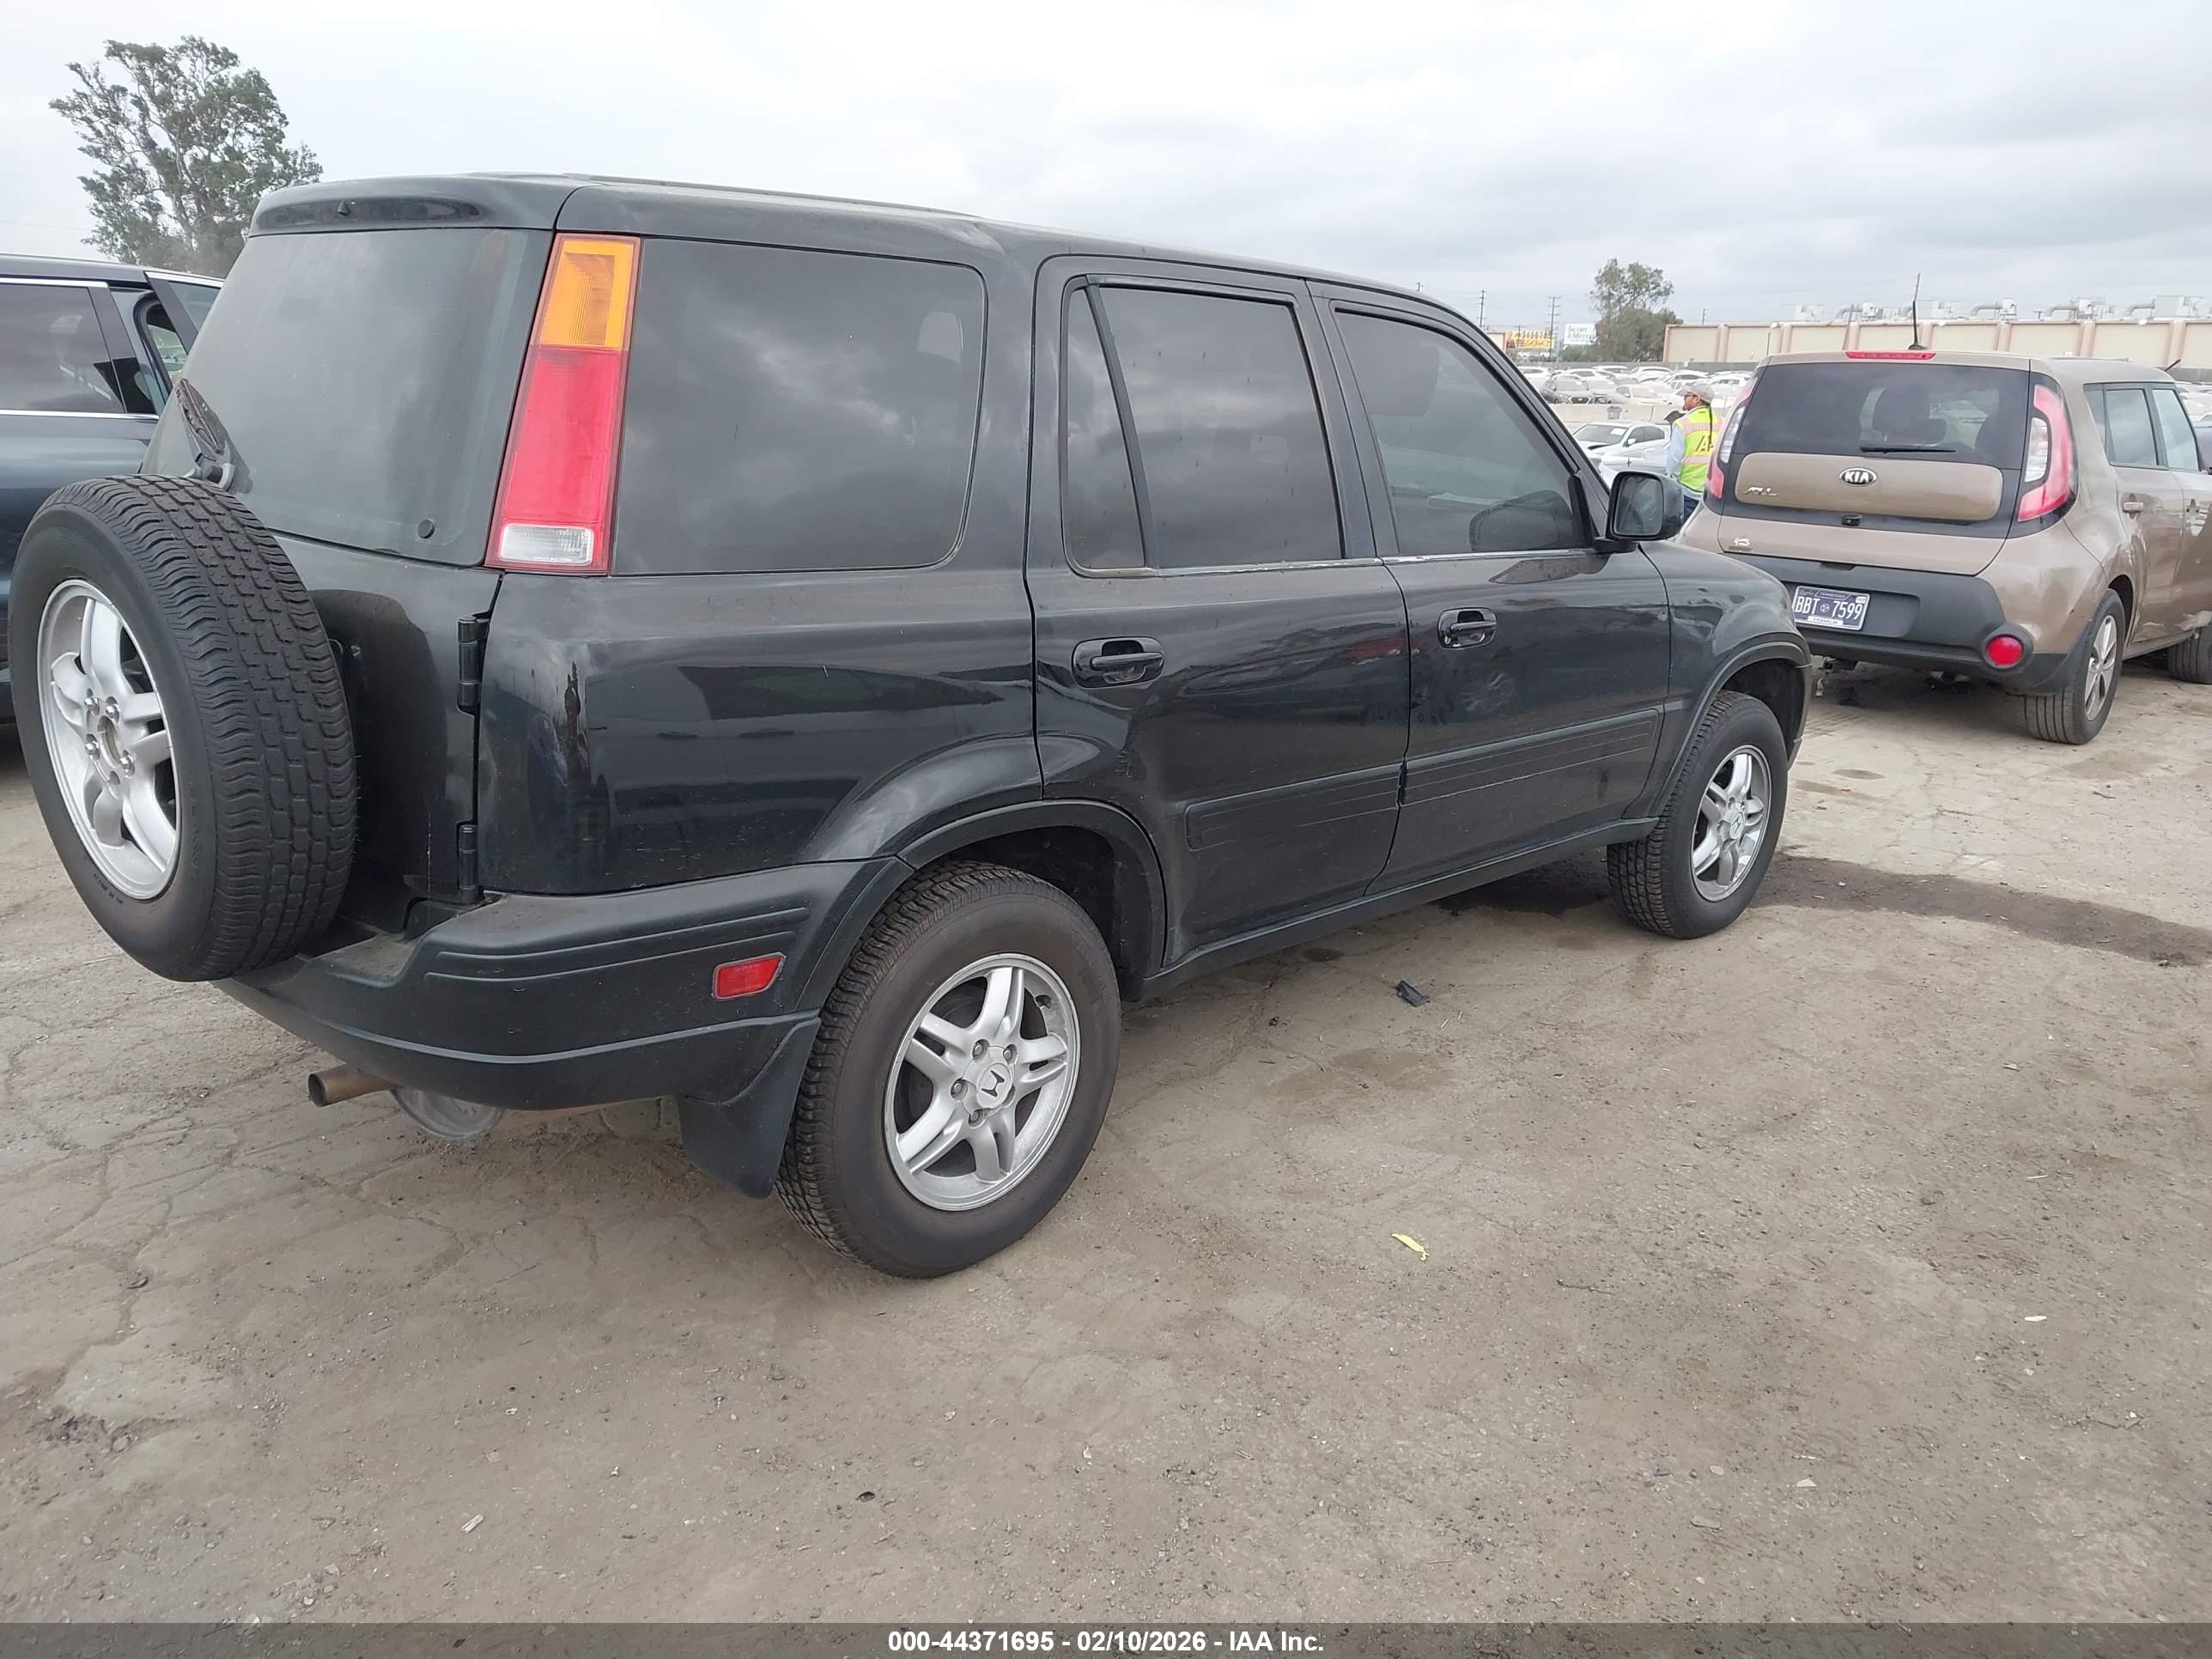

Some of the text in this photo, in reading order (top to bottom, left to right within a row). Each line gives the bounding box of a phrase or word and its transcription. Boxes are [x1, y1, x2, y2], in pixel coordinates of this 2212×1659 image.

[1845, 471, 1869, 483] KIA
[1795, 596, 1863, 620] BBT 7599
